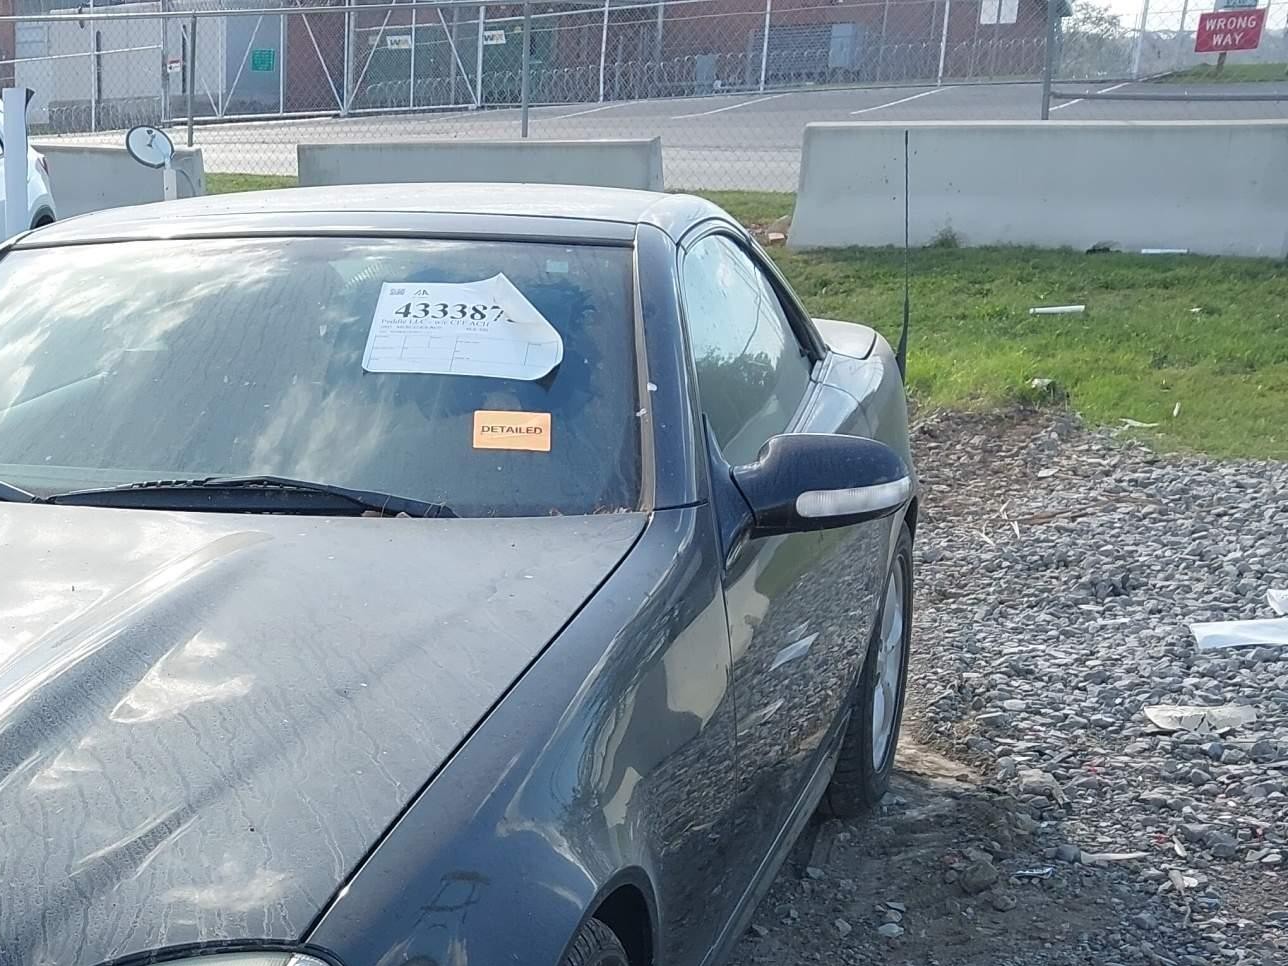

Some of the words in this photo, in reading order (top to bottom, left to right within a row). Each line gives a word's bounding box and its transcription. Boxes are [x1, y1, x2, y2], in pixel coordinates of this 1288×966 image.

[1206, 15, 1257, 31] WRONG
[1212, 31, 1244, 47] WAY
[481, 425, 543, 435] DETAILED
